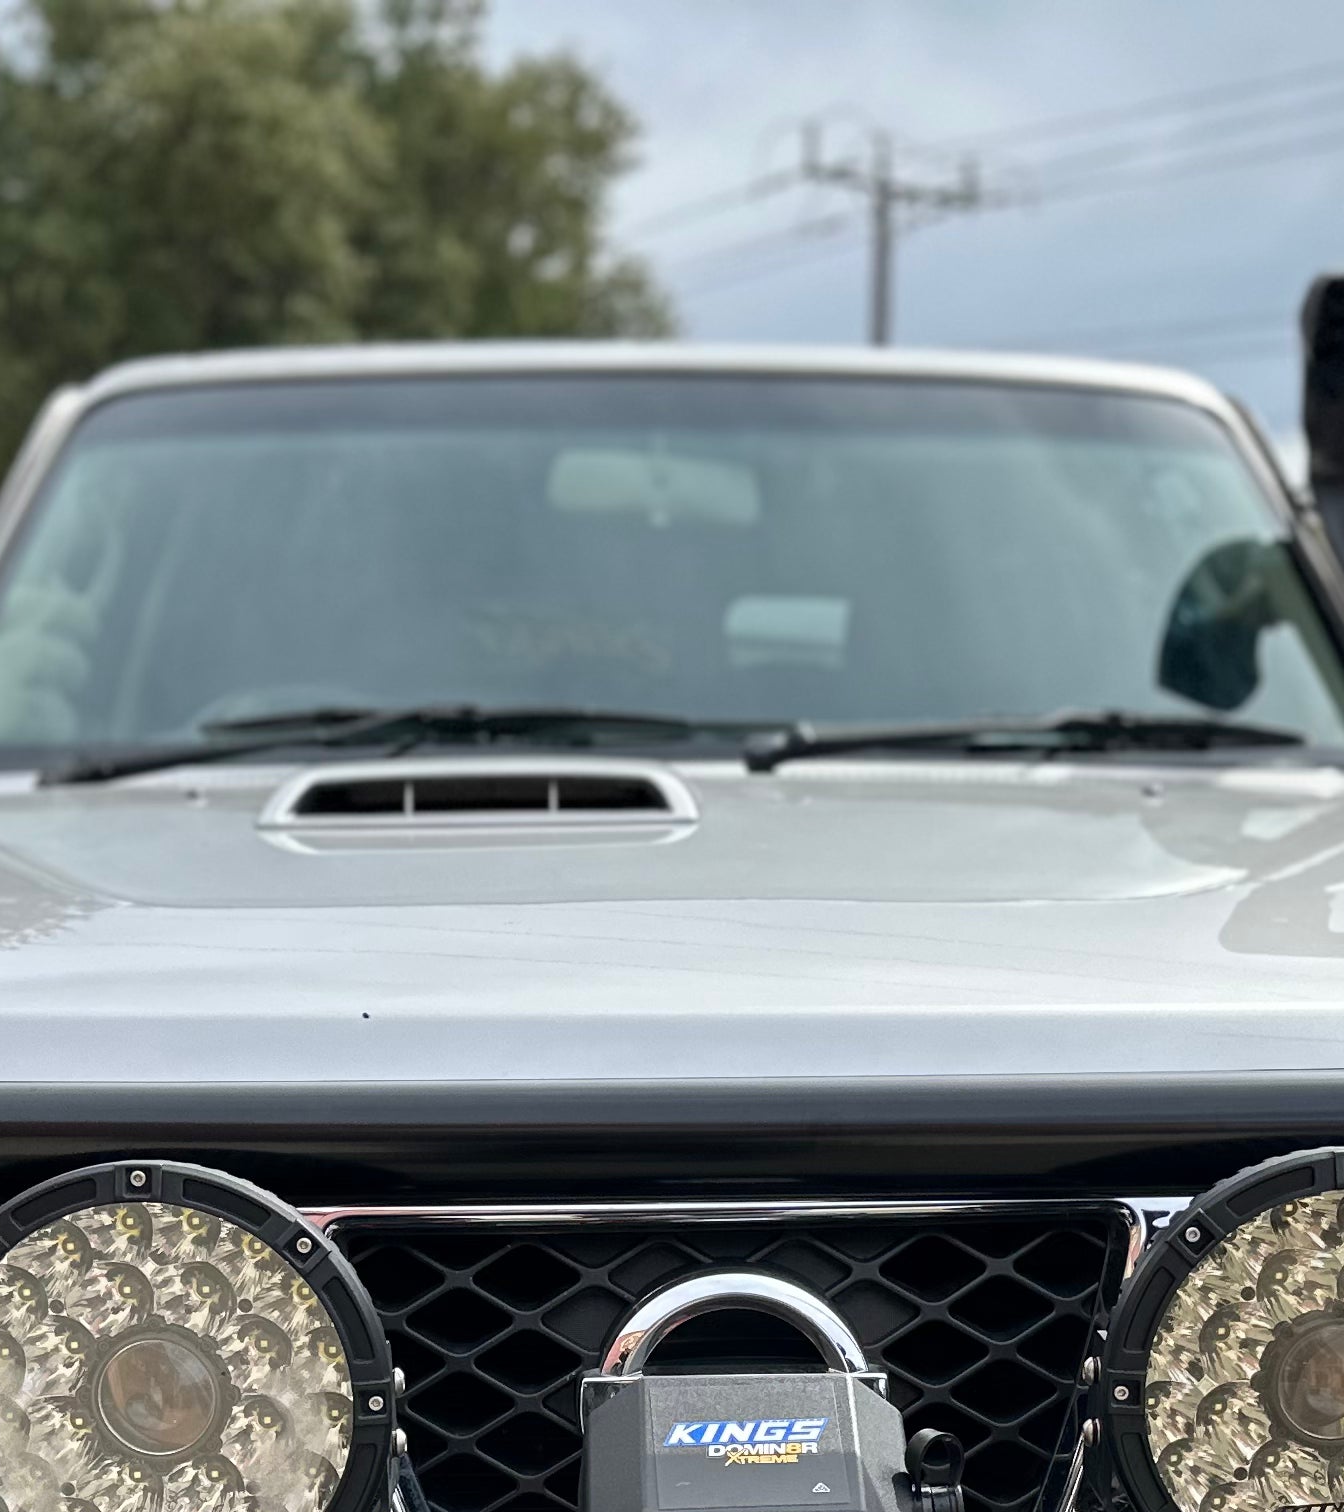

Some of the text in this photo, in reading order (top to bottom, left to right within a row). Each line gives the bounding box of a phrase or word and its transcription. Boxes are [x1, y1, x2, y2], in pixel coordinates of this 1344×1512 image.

[666, 1418, 828, 1446] KINGS
[707, 1441, 819, 1458] DOMIN8R
[724, 1450, 800, 1467] XTREME
